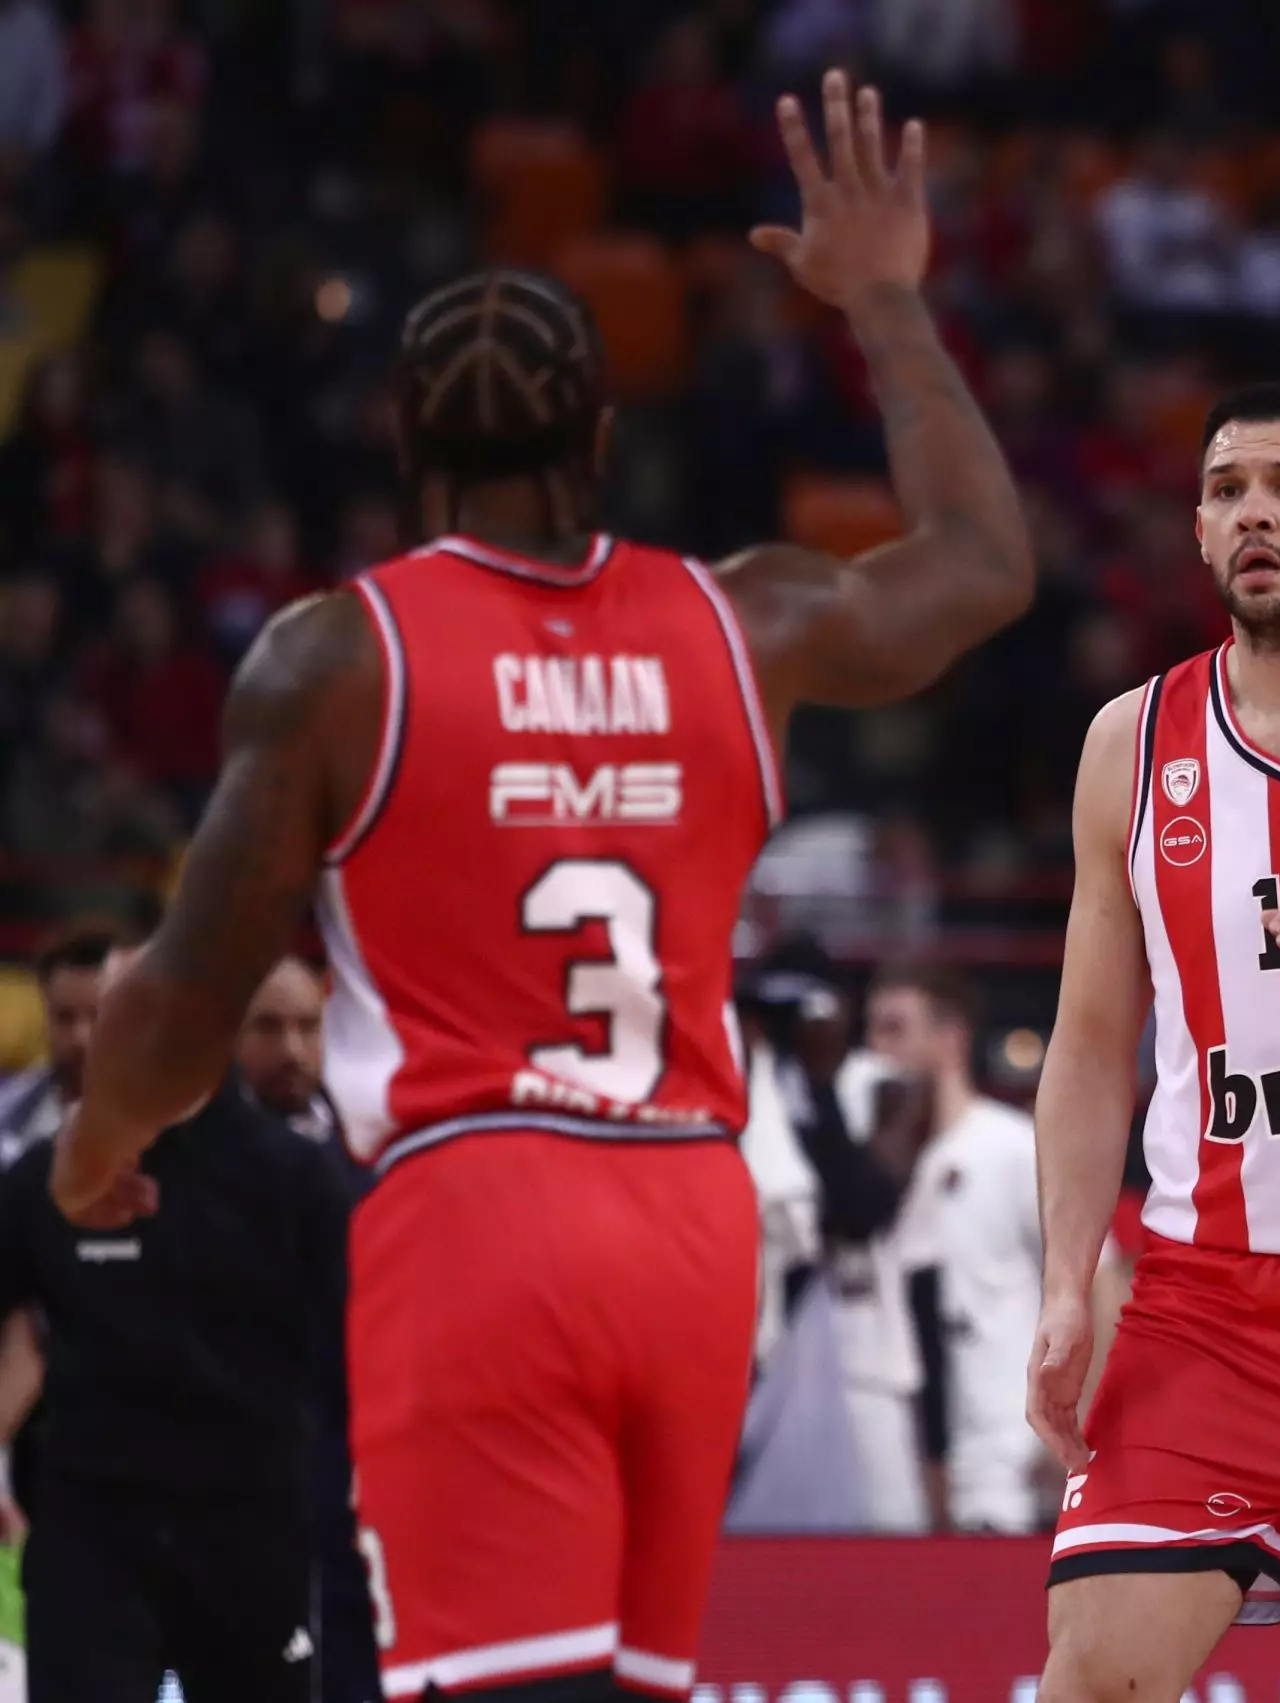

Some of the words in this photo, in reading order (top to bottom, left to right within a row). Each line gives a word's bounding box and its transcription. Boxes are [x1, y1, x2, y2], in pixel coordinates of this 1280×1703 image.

[493, 652, 670, 734] CANAAN
[489, 762, 684, 821] FMS
[1164, 835, 1202, 847] GSA
[521, 858, 665, 1105] 3
